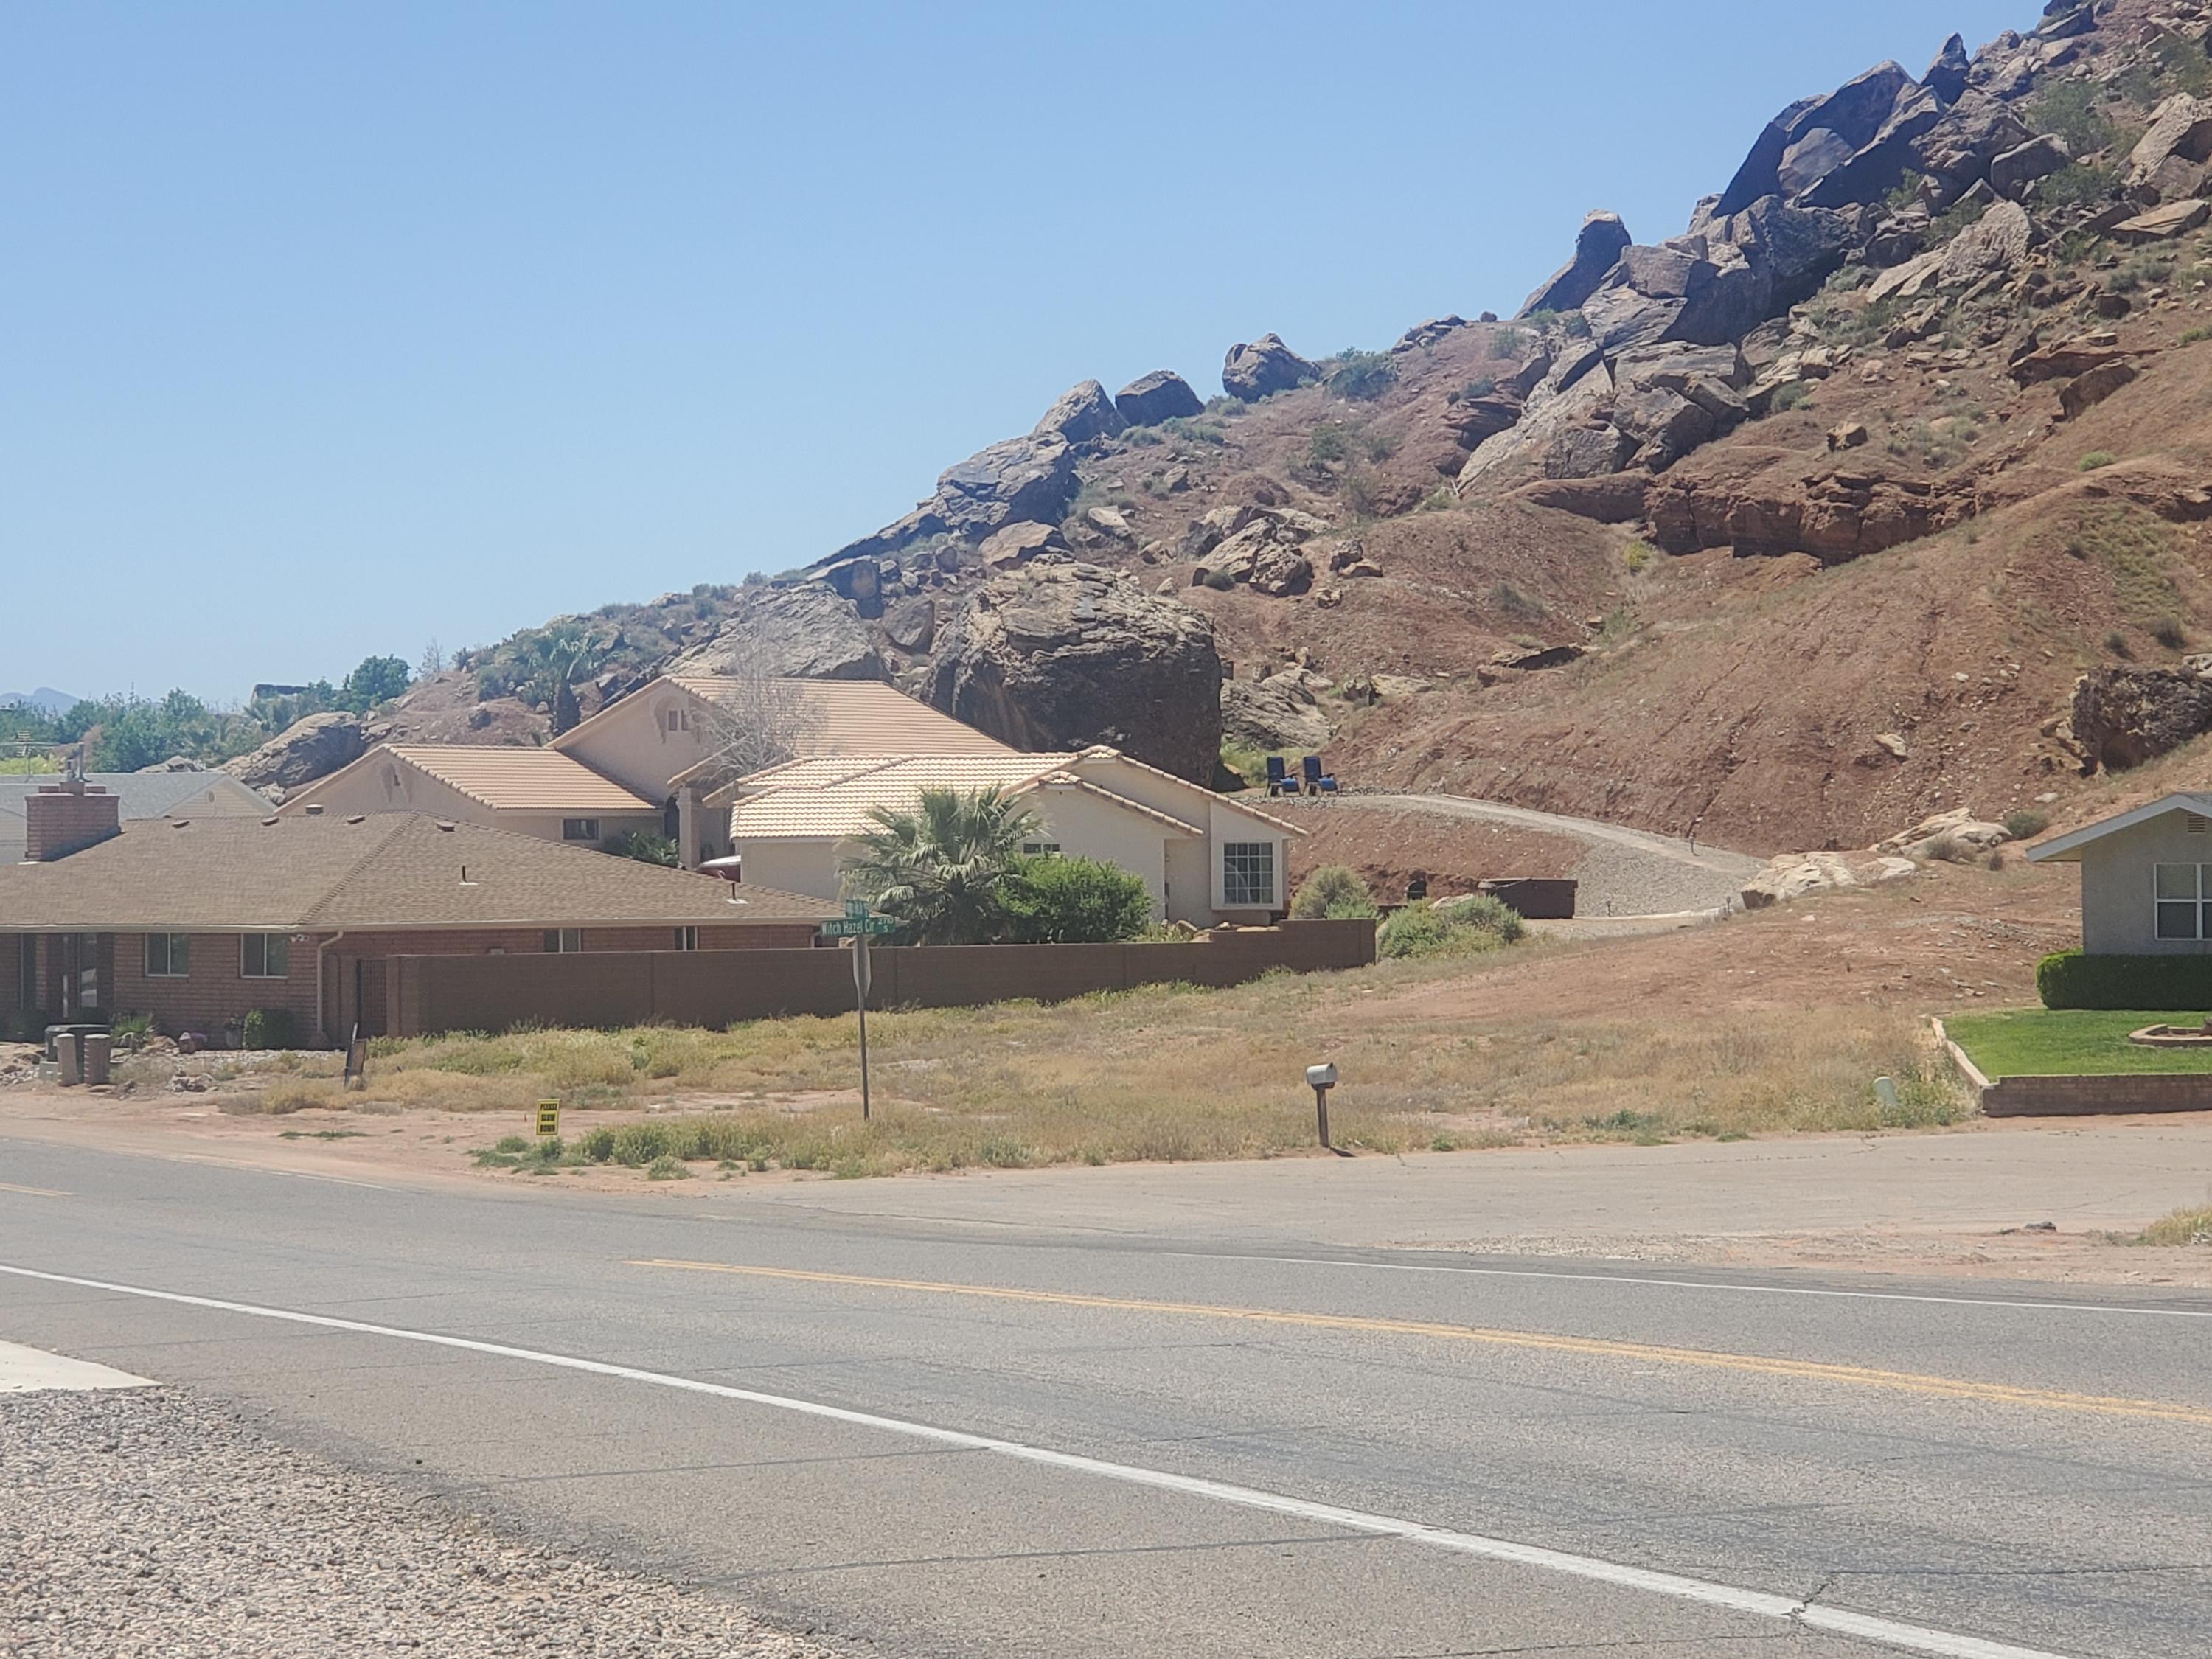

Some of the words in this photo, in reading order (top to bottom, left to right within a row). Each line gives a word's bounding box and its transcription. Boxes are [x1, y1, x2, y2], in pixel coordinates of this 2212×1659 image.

[821, 922, 841, 936] Witch
[843, 920, 863, 934] Hazel
[865, 919, 874, 933] Cir
